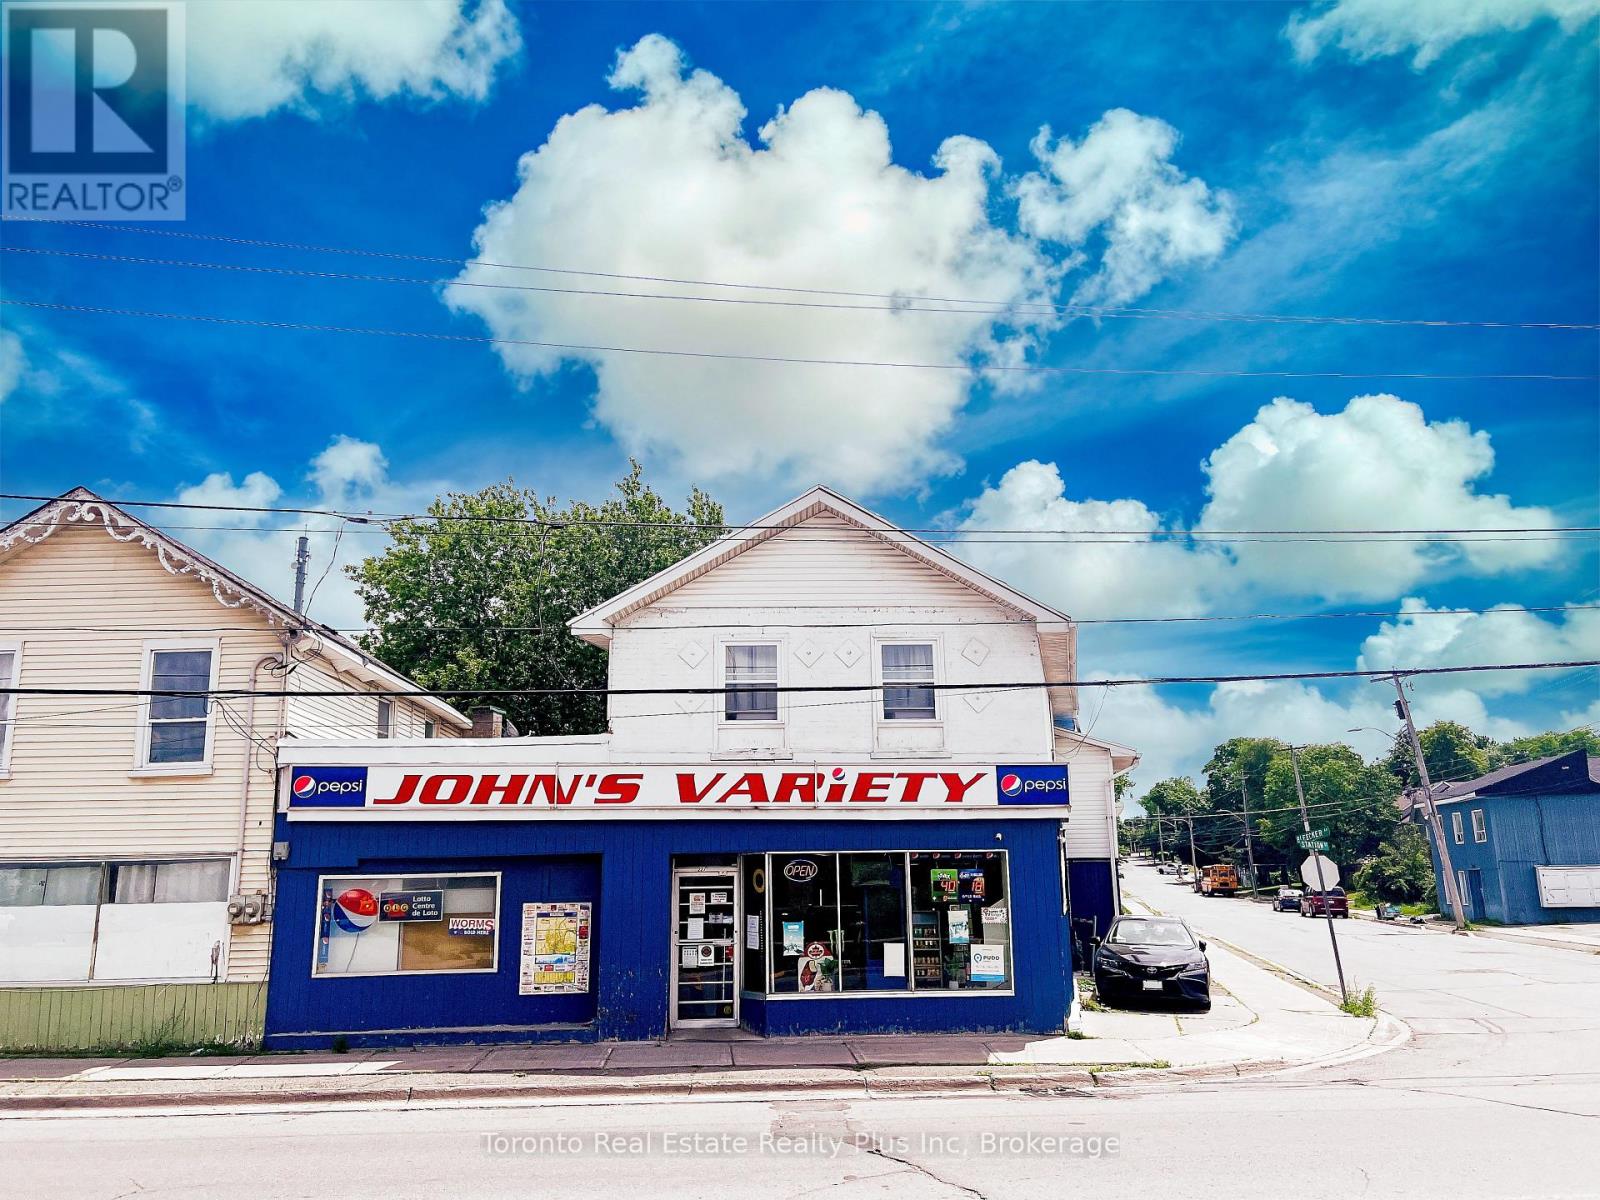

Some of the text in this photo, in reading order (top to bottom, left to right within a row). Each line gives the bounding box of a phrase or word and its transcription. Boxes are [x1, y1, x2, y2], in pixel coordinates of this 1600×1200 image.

[317, 779, 363, 795] pepsi
[373, 773, 644, 805] JOHN'S
[1024, 777, 1068, 793] pepsi
[786, 865, 815, 877] OPEN
[940, 880, 956, 892] 40
[971, 880, 983, 892] 18
[450, 919, 494, 931] WORMS
